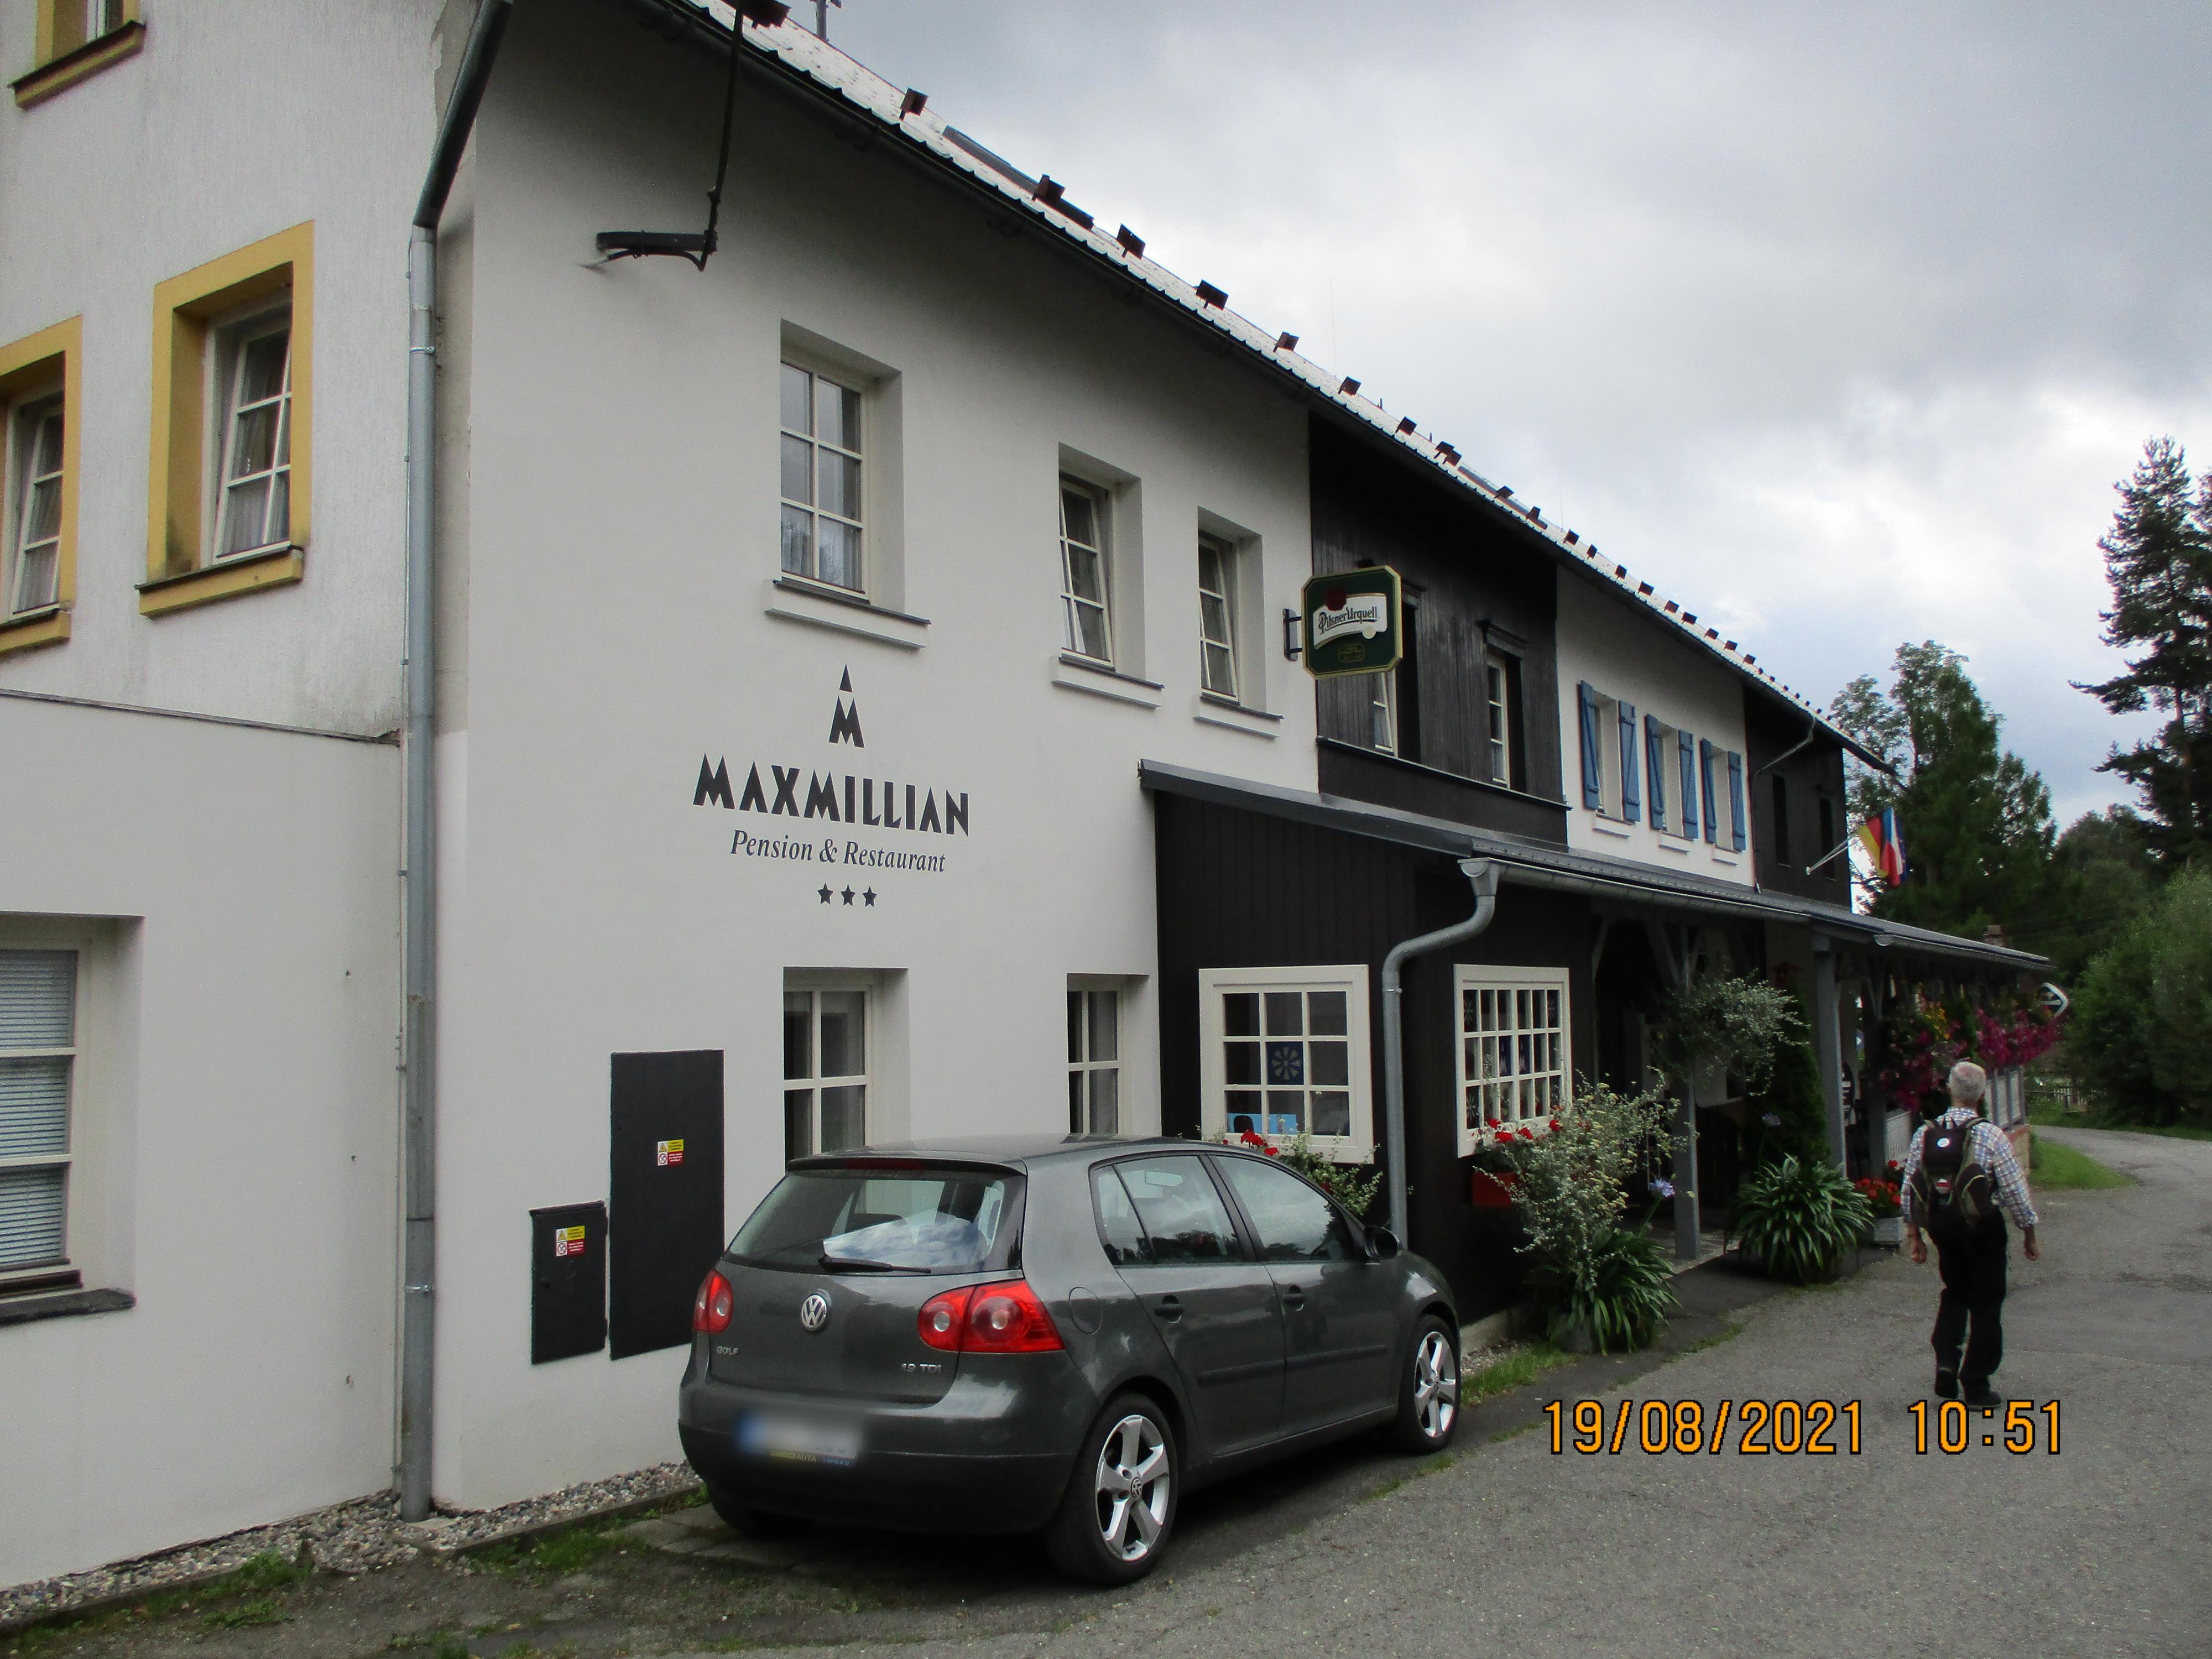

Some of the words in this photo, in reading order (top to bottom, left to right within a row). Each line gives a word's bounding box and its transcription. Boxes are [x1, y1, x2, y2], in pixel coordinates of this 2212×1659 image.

[1318, 611, 1347, 635] Pilsner
[1345, 606, 1378, 624] Urquell
[693, 753, 968, 837] MAXMILLIAN
[730, 830, 813, 861] Pension
[818, 838, 837, 864] &
[843, 841, 946, 873] Restaurant
[716, 1345, 738, 1355] GOLF
[919, 1364, 942, 1374] TDI
